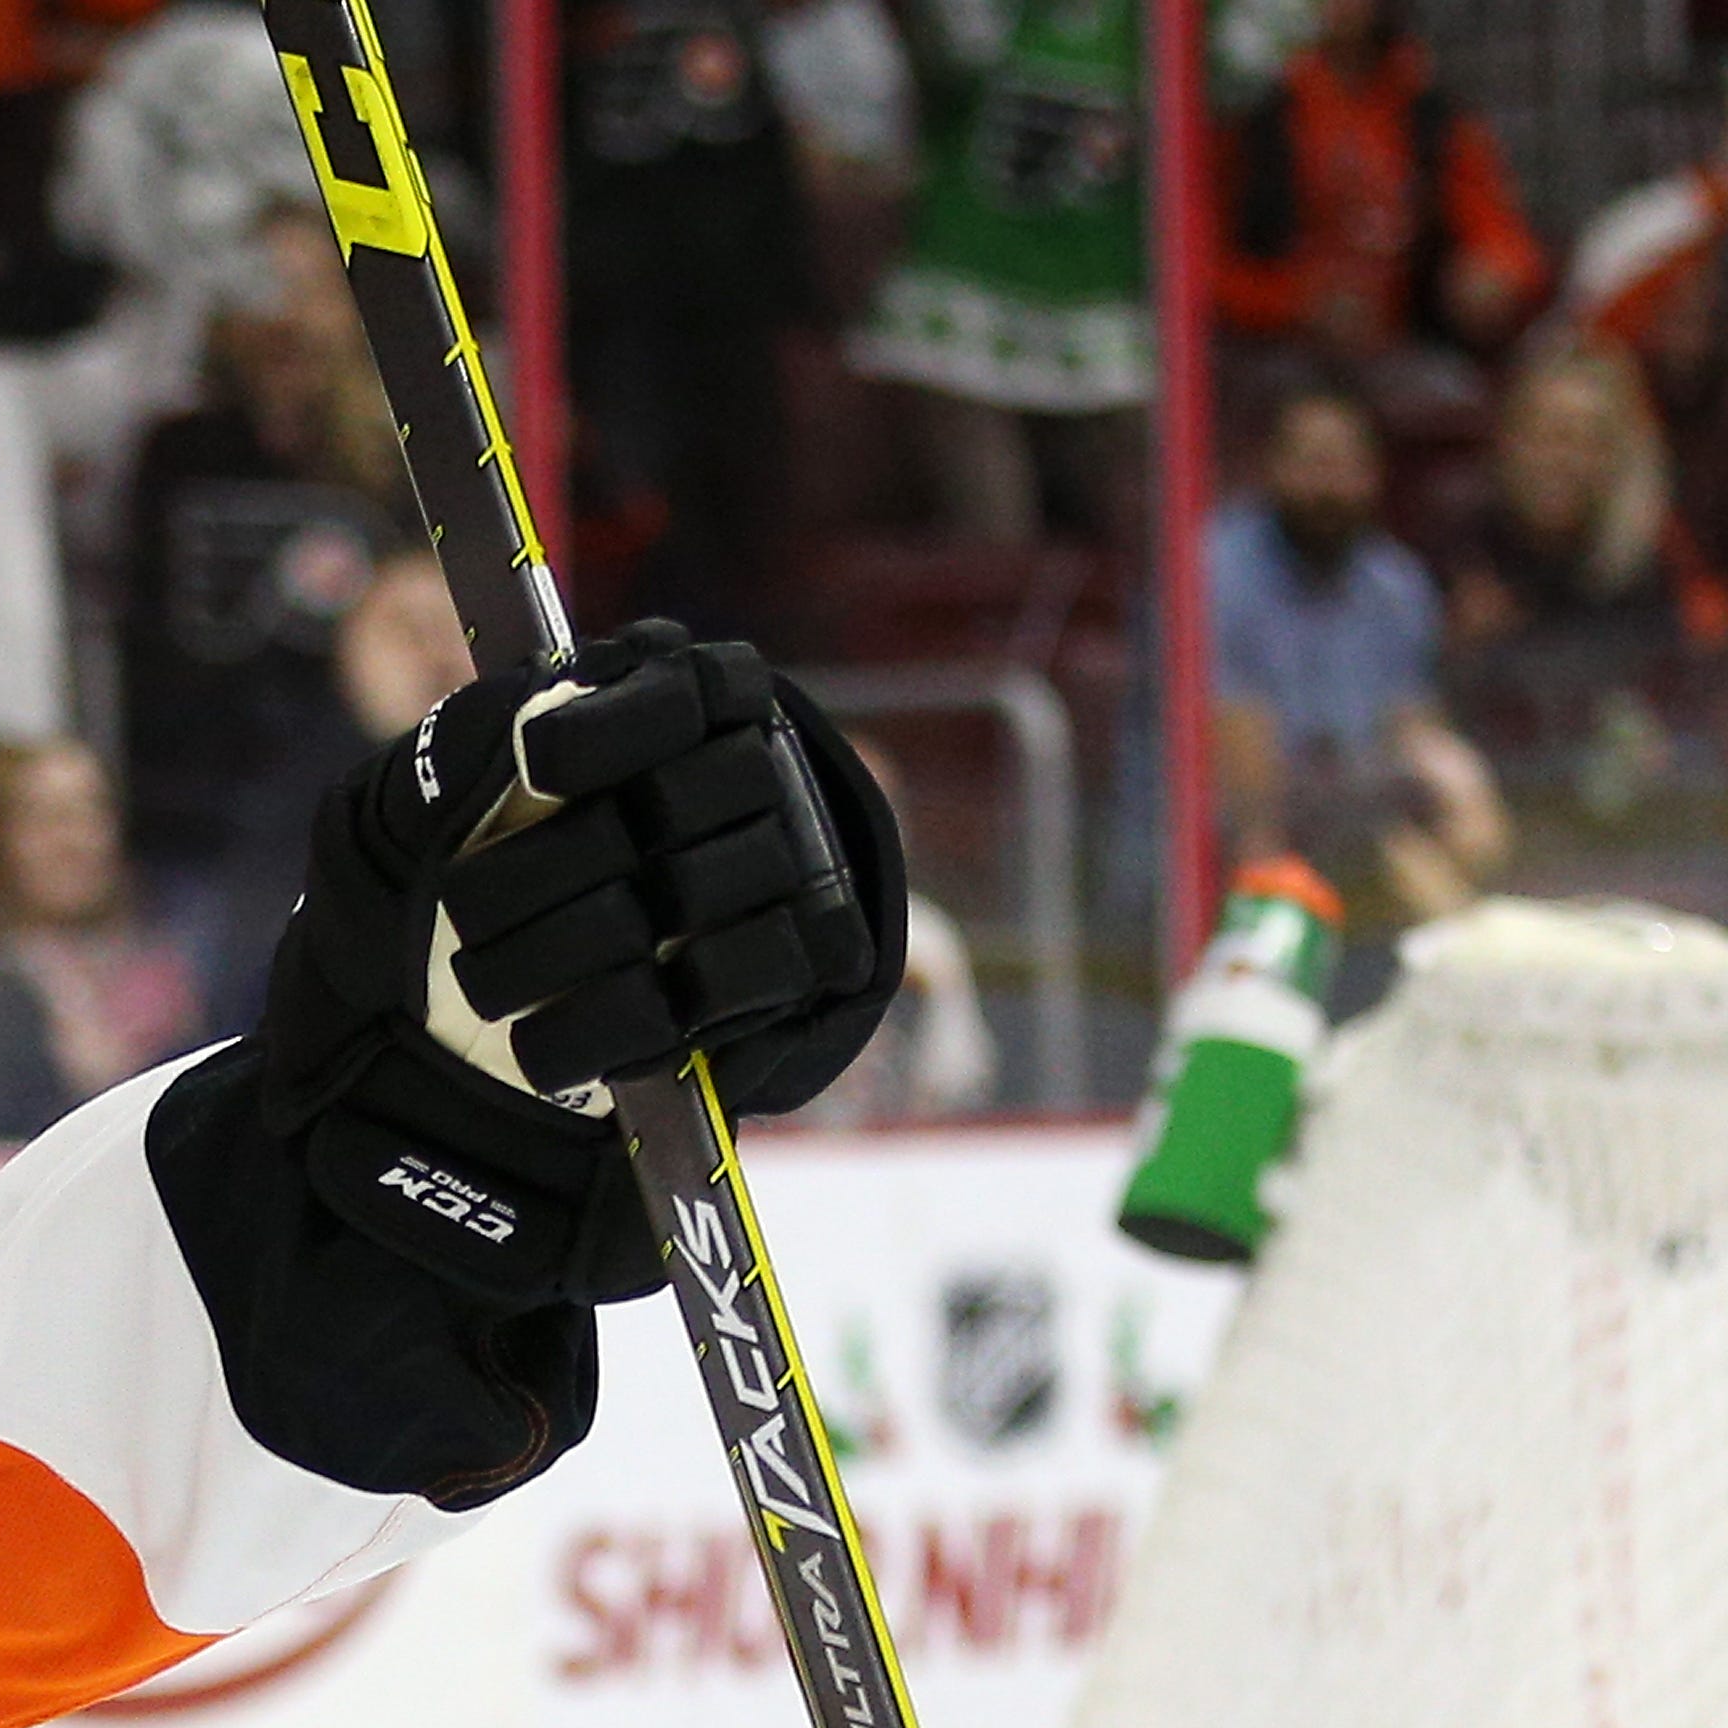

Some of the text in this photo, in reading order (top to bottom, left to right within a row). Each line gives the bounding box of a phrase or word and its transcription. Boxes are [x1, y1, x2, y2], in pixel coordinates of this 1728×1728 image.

[378, 1167, 515, 1244] CCM
[431, 1170, 488, 1203] PRO
[671, 1195, 843, 1553] TACKS
